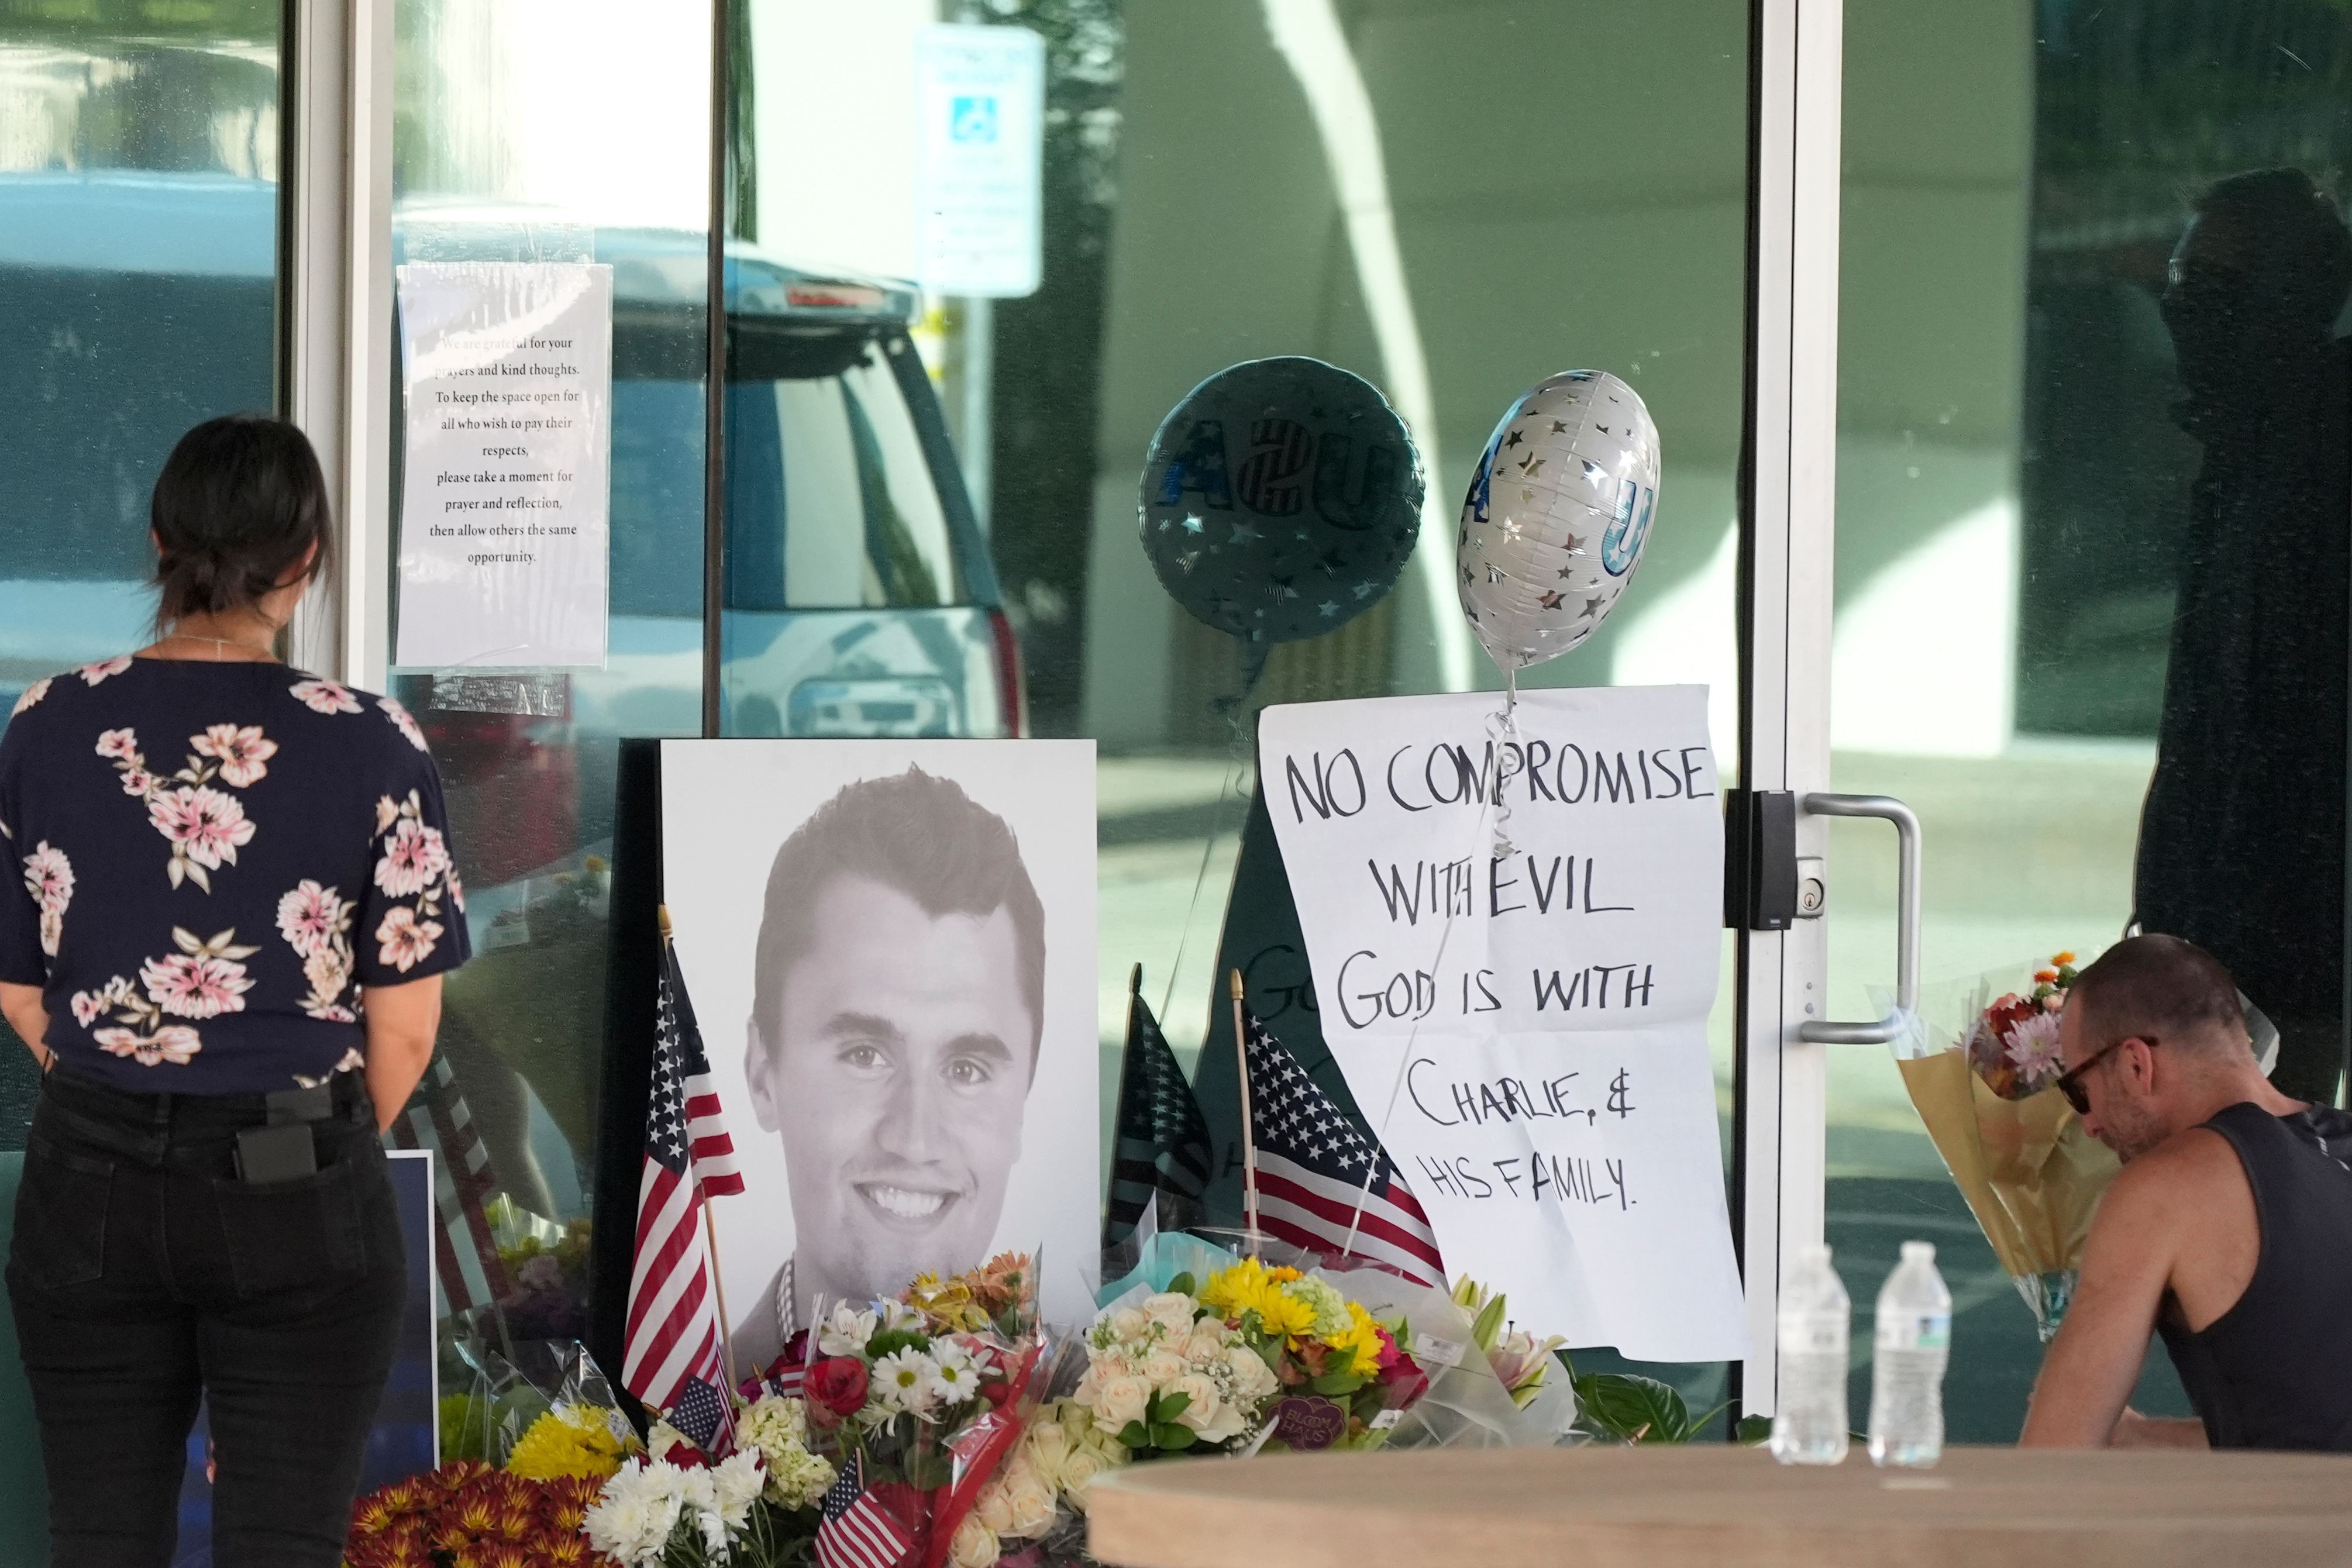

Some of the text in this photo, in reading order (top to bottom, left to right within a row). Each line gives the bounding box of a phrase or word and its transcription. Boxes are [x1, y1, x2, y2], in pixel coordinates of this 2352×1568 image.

[463, 340, 479, 349] are
[483, 337, 526, 352] grateful
[530, 336, 546, 349] for
[549, 340, 573, 351] your
[477, 363, 498, 375] and
[501, 363, 526, 375] kind
[529, 363, 580, 378] thoughts.
[435, 389, 579, 405] To keep the space open for
[441, 417, 573, 432] all who wish to pay their
[482, 446, 529, 459] respects,
[437, 469, 573, 486] please take a moment for
[445, 496, 563, 513] prayer and reflection,
[430, 523, 577, 536] then allow others the same
[468, 550, 536, 566] opportunity.
[1286, 739, 1716, 824] NO COMPROMISE
[1368, 850, 1635, 927] WITH EVIL
[1337, 950, 1655, 1030] GOD IS WITH
[1407, 1058, 1597, 1126] CHARLIE,
[1607, 1067, 1637, 1118] &
[1416, 1150, 1638, 1211] HIS FAMILY.
